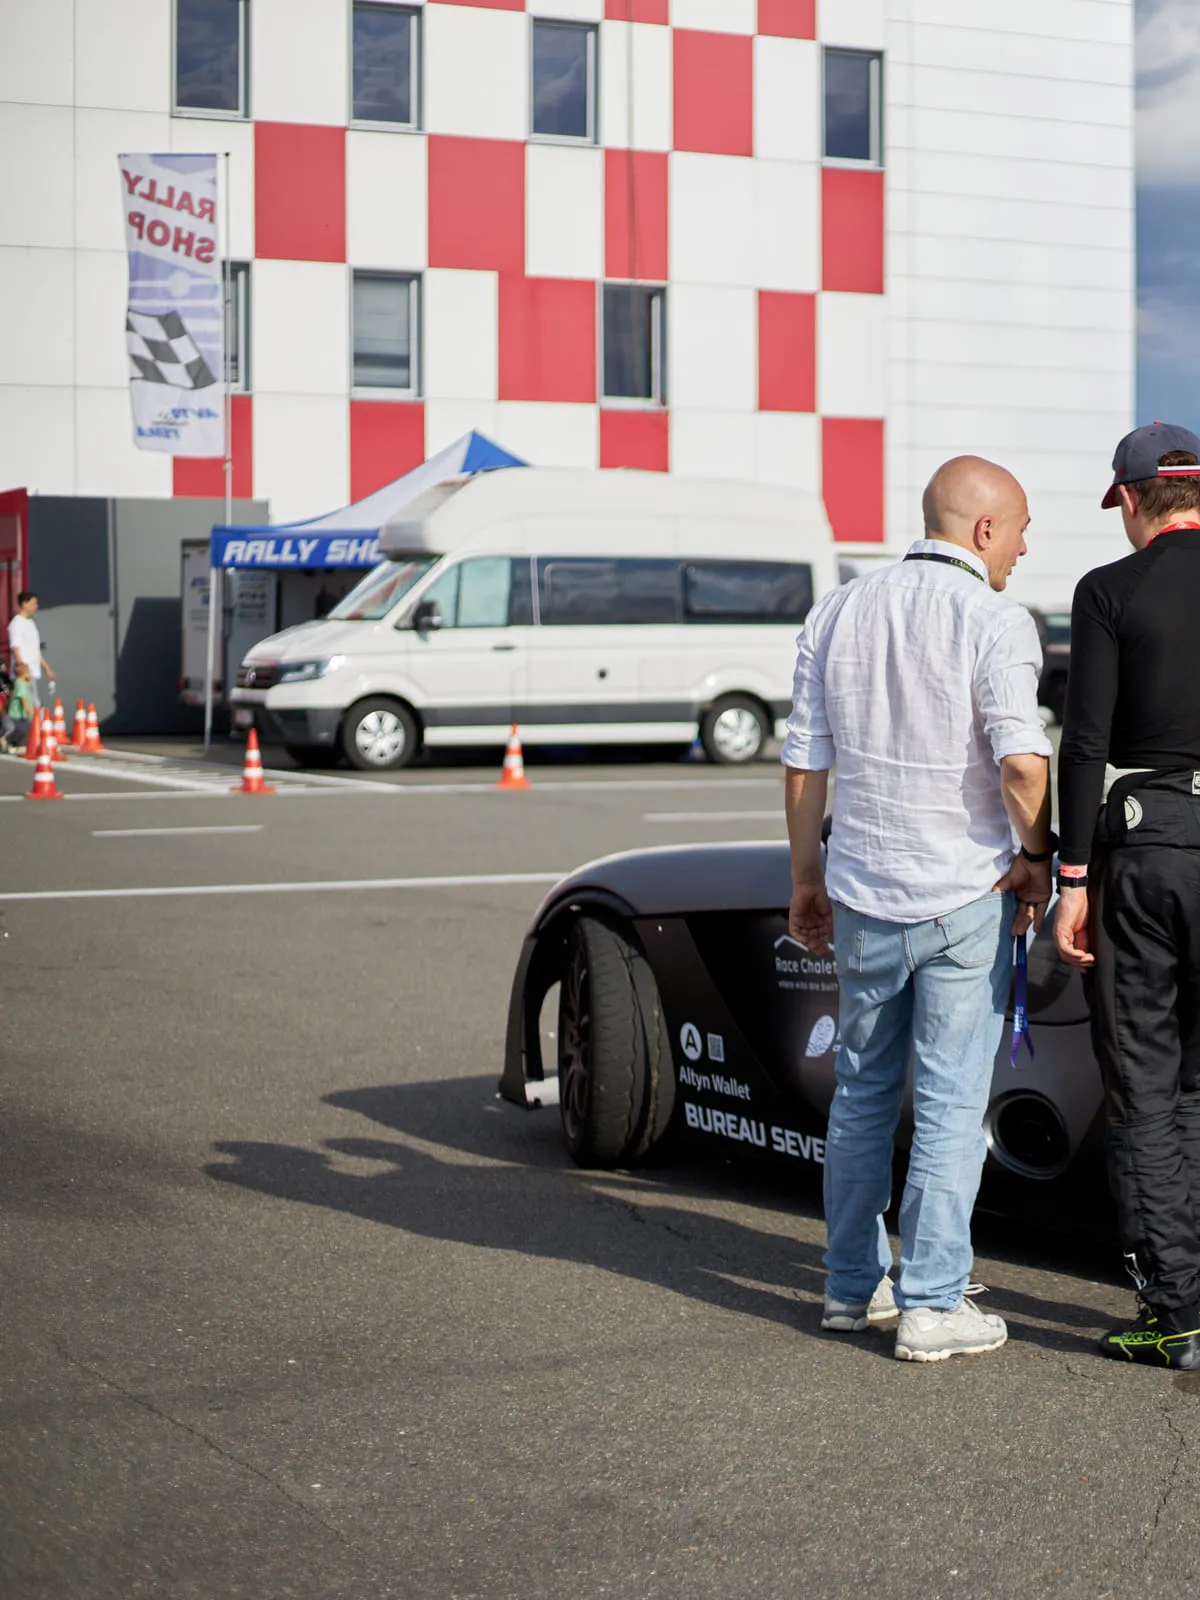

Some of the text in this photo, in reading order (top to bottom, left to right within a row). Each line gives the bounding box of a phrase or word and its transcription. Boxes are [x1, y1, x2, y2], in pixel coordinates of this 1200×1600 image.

[223, 539, 320, 563] RALLY
[775, 957, 800, 973] Race
[679, 1065, 751, 1101] Altyn Wallet
[684, 1101, 767, 1147] BUREAU
